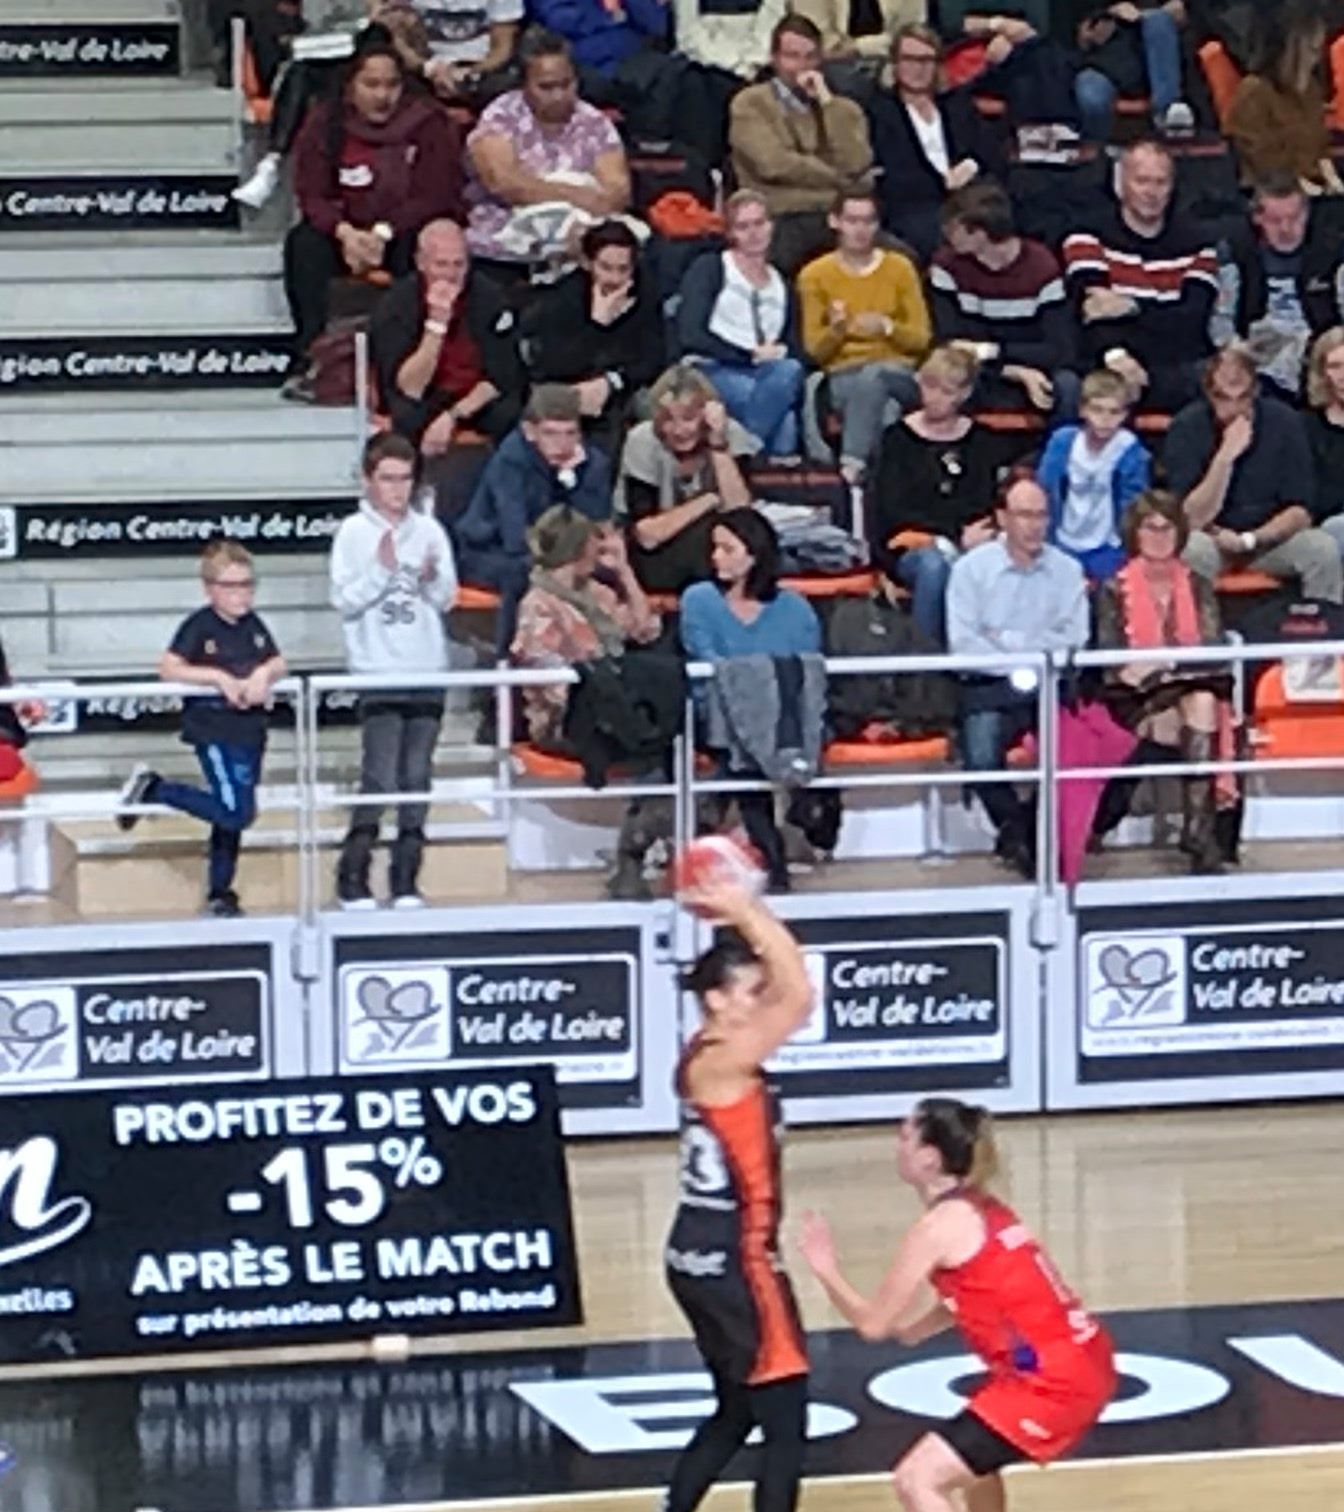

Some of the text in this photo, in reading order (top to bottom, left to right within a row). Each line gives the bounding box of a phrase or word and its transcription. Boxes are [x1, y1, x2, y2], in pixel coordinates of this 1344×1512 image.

[79, 37, 108, 61] de
[110, 38, 169, 61] Loire
[136, 189, 167, 213] de
[169, 190, 229, 213] Loire
[65, 351, 197, 377] Centre-Val
[198, 350, 229, 373] de
[230, 350, 291, 373] Loire
[25, 516, 122, 547] Région
[126, 514, 261, 540] Centre-Val
[261, 513, 293, 538] de
[1191, 942, 1306, 972] Centre-
[456, 973, 577, 1006] Centre-
[832, 959, 949, 989] Centre-
[83, 992, 208, 1025] Centre-
[1192, 978, 1238, 1009] Val
[1239, 977, 1277, 1008] de
[832, 992, 995, 1028] Val de Loire
[458, 1009, 626, 1045] Val de Loire
[85, 1028, 257, 1064] Val de Loire
[114, 1081, 537, 1146] PROFITEZ DE VOS
[226, 1136, 443, 1229] -15%
[130, 1229, 552, 1297] APRÈS LE MATCH
[136, 1283, 557, 1338] sur présentation de votre Rebond
